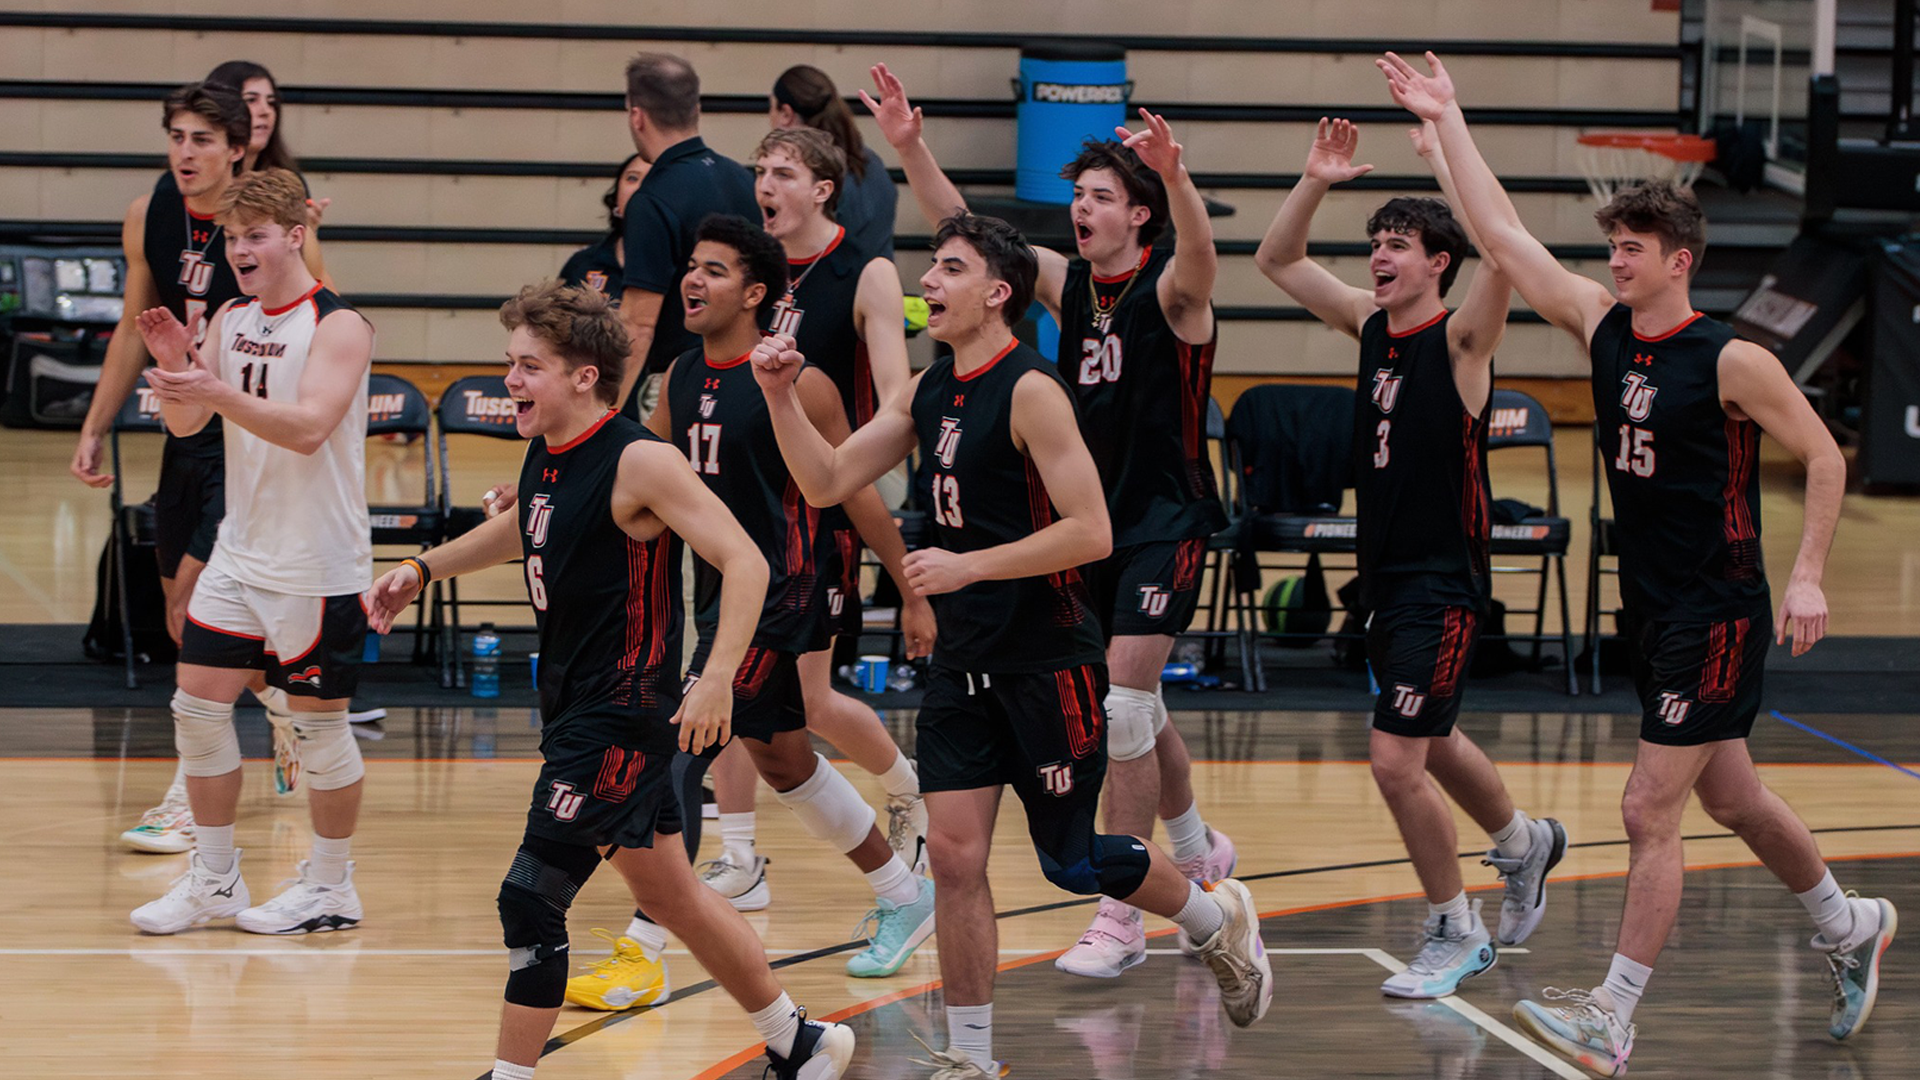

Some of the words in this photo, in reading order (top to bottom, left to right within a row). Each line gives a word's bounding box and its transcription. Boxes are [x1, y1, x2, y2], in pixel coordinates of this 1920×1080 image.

[179, 250, 214, 294] TU
[769, 300, 803, 338] TU
[1078, 333, 1120, 385] 20
[699, 393, 717, 419] TU
[1373, 368, 1402, 413] TU
[1619, 371, 1657, 422] TU
[687, 422, 722, 475] 17
[935, 416, 961, 468] TU
[1374, 420, 1391, 469] 3
[1615, 424, 1655, 478] 15
[527, 494, 554, 548] TU
[932, 473, 963, 528] 13
[527, 554, 548, 612] 6
[827, 587, 844, 616] TU
[1138, 584, 1170, 617] TU
[1393, 684, 1425, 718] TU
[1658, 691, 1691, 725] TU
[546, 780, 587, 822] TU
[1038, 762, 1073, 796] TU
